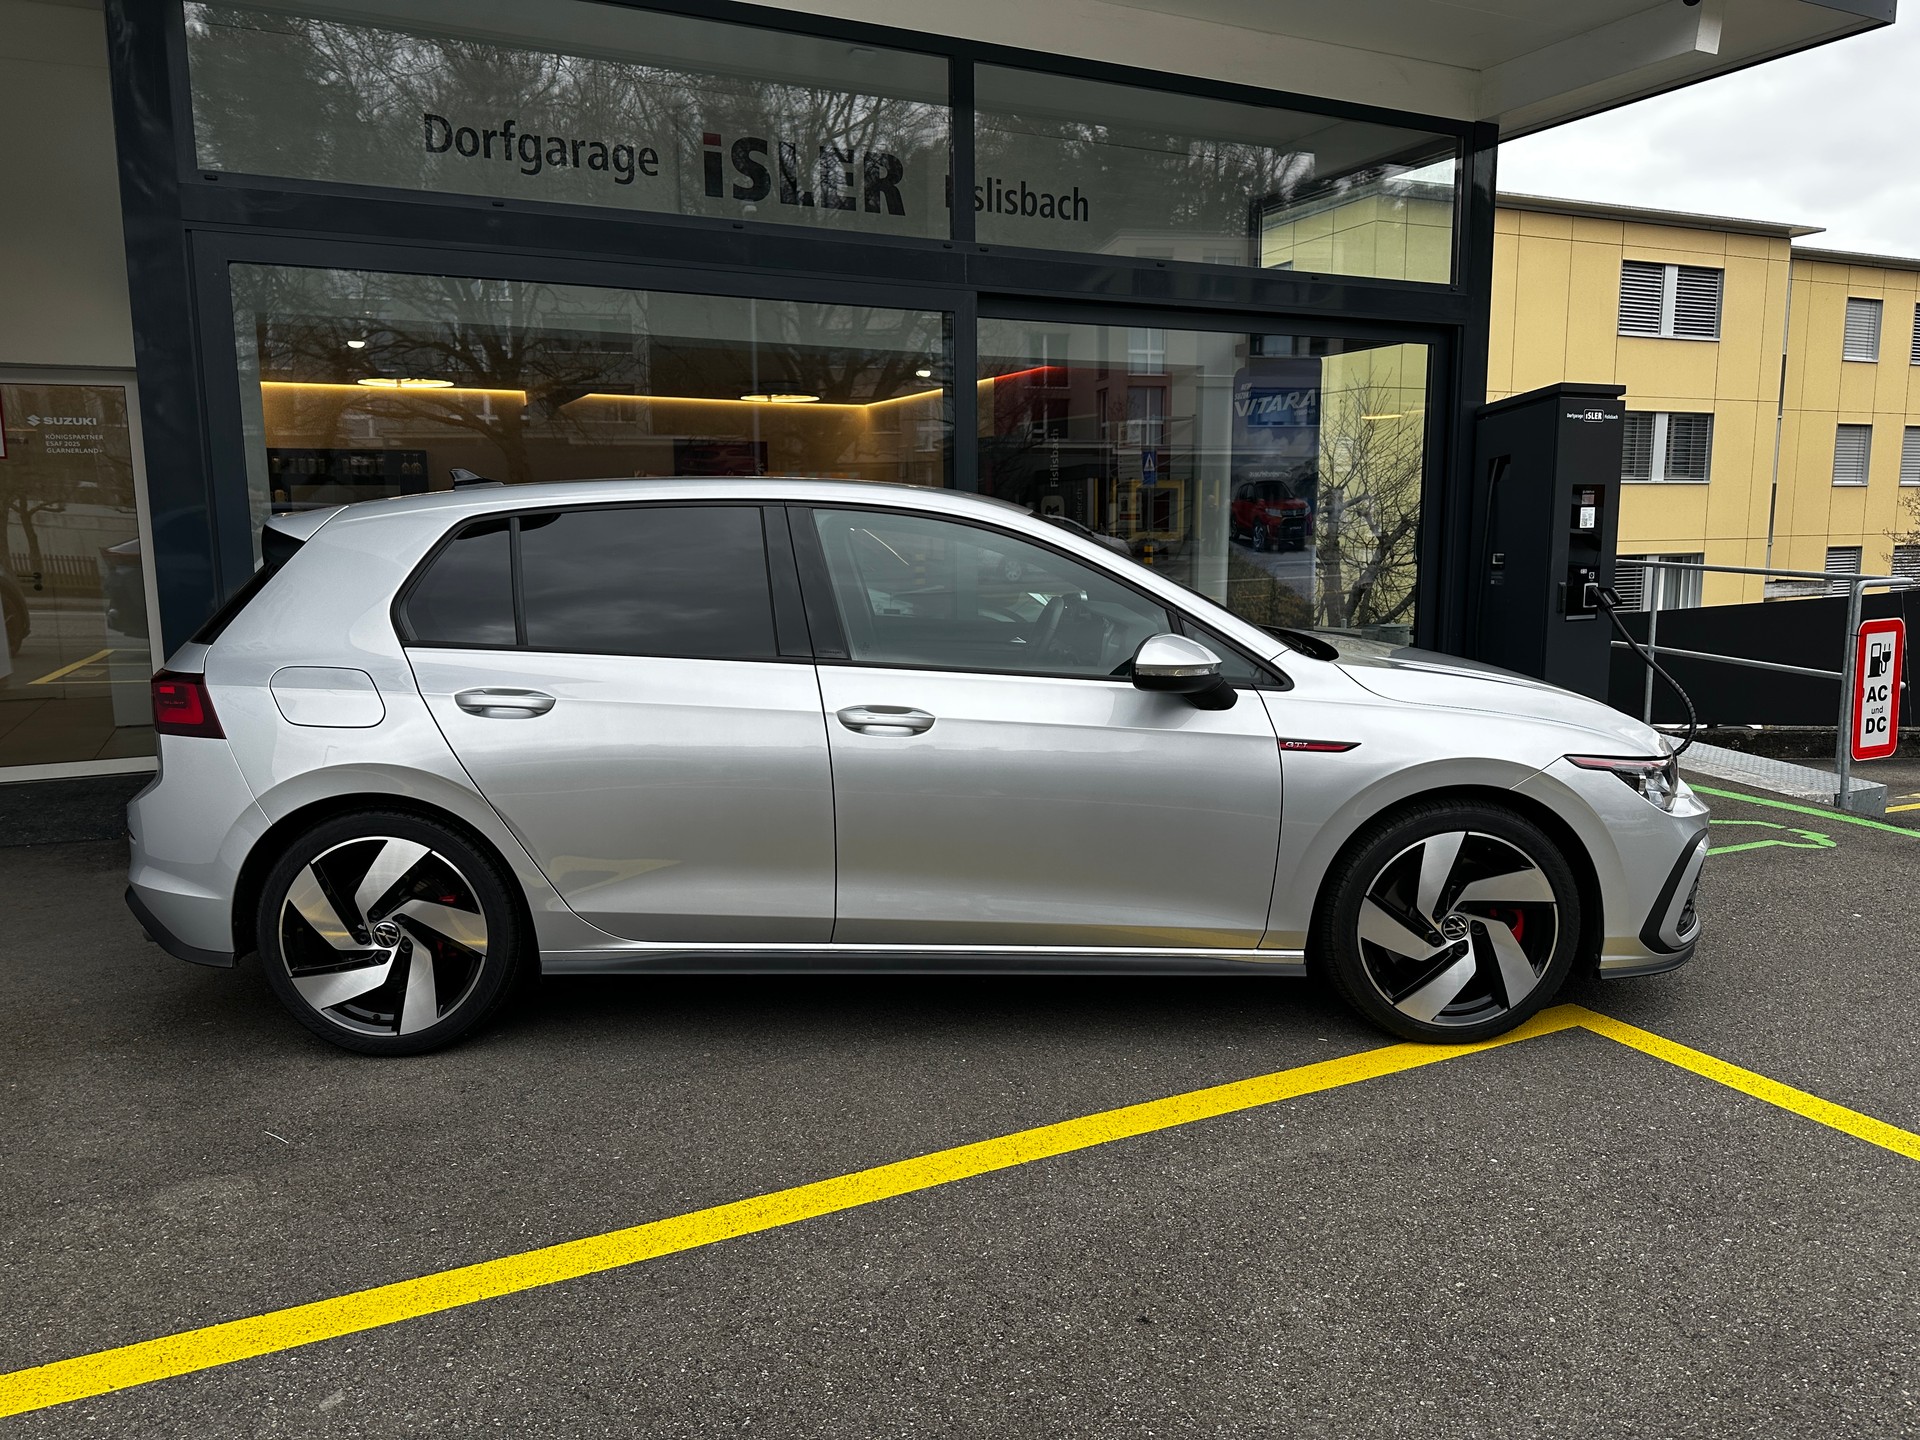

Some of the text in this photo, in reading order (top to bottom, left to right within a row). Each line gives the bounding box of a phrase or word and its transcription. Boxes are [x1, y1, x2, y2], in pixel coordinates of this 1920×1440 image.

[424, 113, 659, 185] Dorfgarage
[1234, 389, 1316, 417] VITARA
[43, 416, 97, 426] SUZUKI
[45, 433, 103, 441] KÖNIGSPARTNER
[1050, 428, 1059, 487] Fislisbach
[1866, 685, 1888, 703] AC
[1871, 706, 1883, 714] und
[1865, 716, 1887, 734] DC
